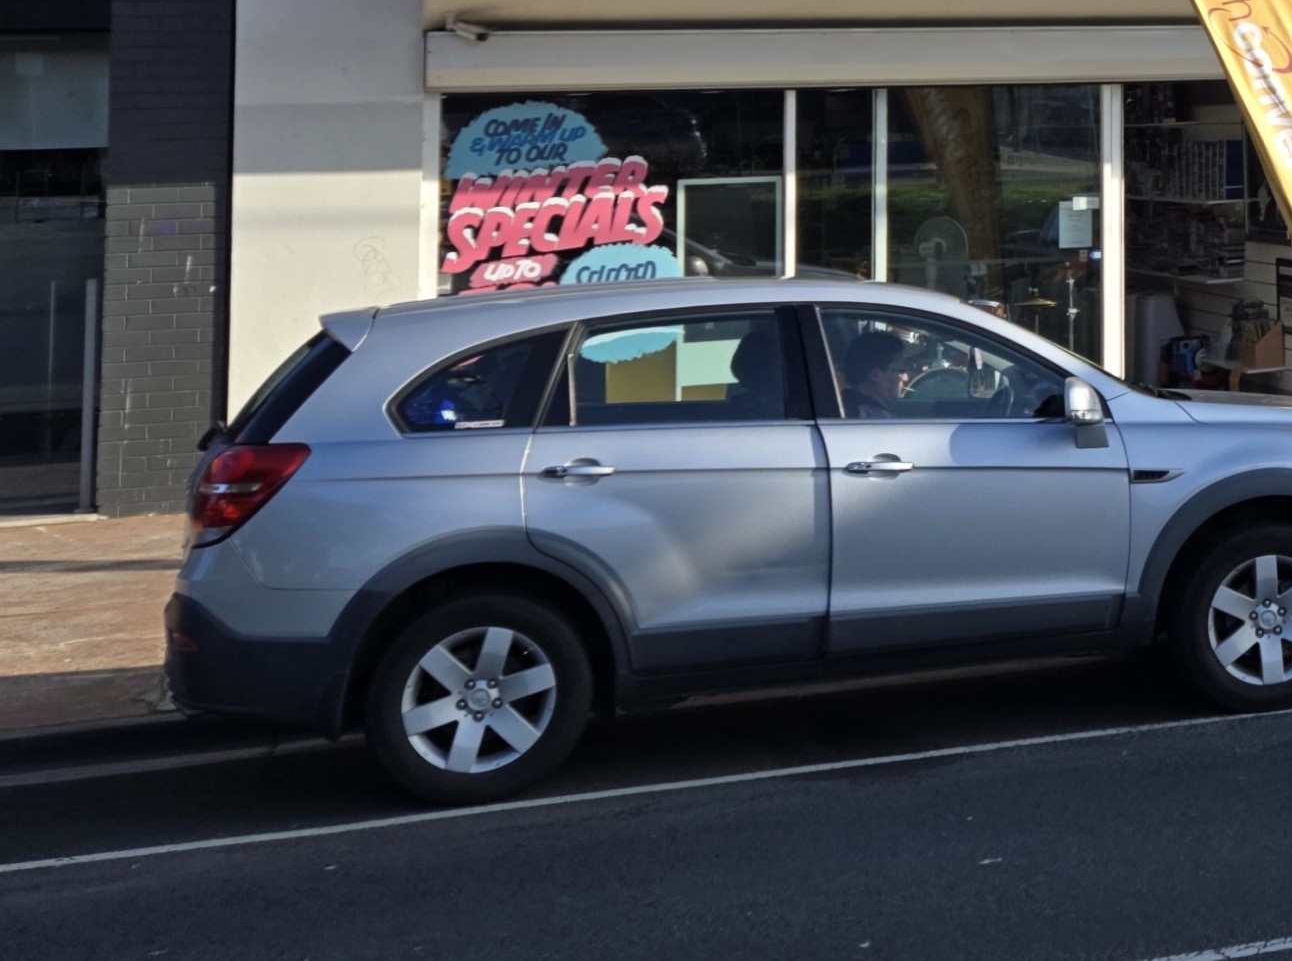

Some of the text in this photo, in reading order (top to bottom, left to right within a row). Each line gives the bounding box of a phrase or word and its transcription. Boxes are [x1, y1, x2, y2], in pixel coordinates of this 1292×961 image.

[484, 112, 566, 139] COME IN
[469, 125, 587, 157] & WARM UP
[494, 142, 569, 166] TO OUR
[448, 154, 651, 214] WINTER
[441, 184, 669, 275] SPECIALS
[483, 259, 542, 281] UP TO
